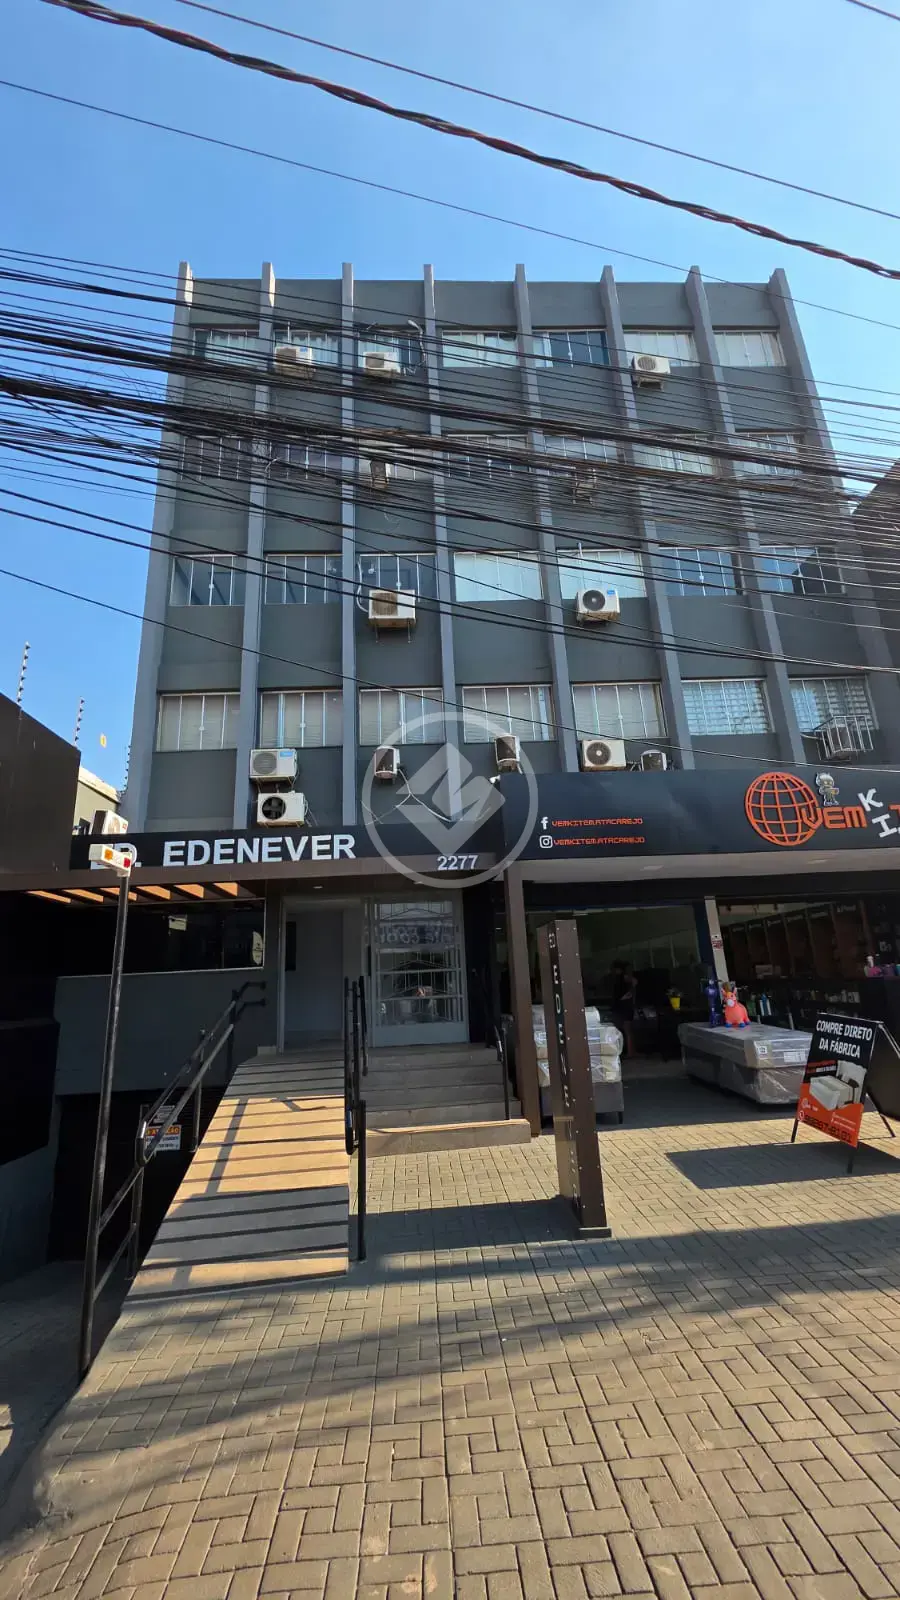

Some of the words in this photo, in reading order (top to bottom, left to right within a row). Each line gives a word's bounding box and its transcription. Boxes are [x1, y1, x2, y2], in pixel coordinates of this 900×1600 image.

[801, 806, 868, 830] VEM
[163, 834, 356, 867] EDENEVER
[437, 855, 478, 871] 2277
[816, 1019, 844, 1036] COMPRE
[843, 1024, 873, 1041] DIRETO
[819, 1037, 829, 1051] DA
[829, 1036, 861, 1059] FÁBRICA
